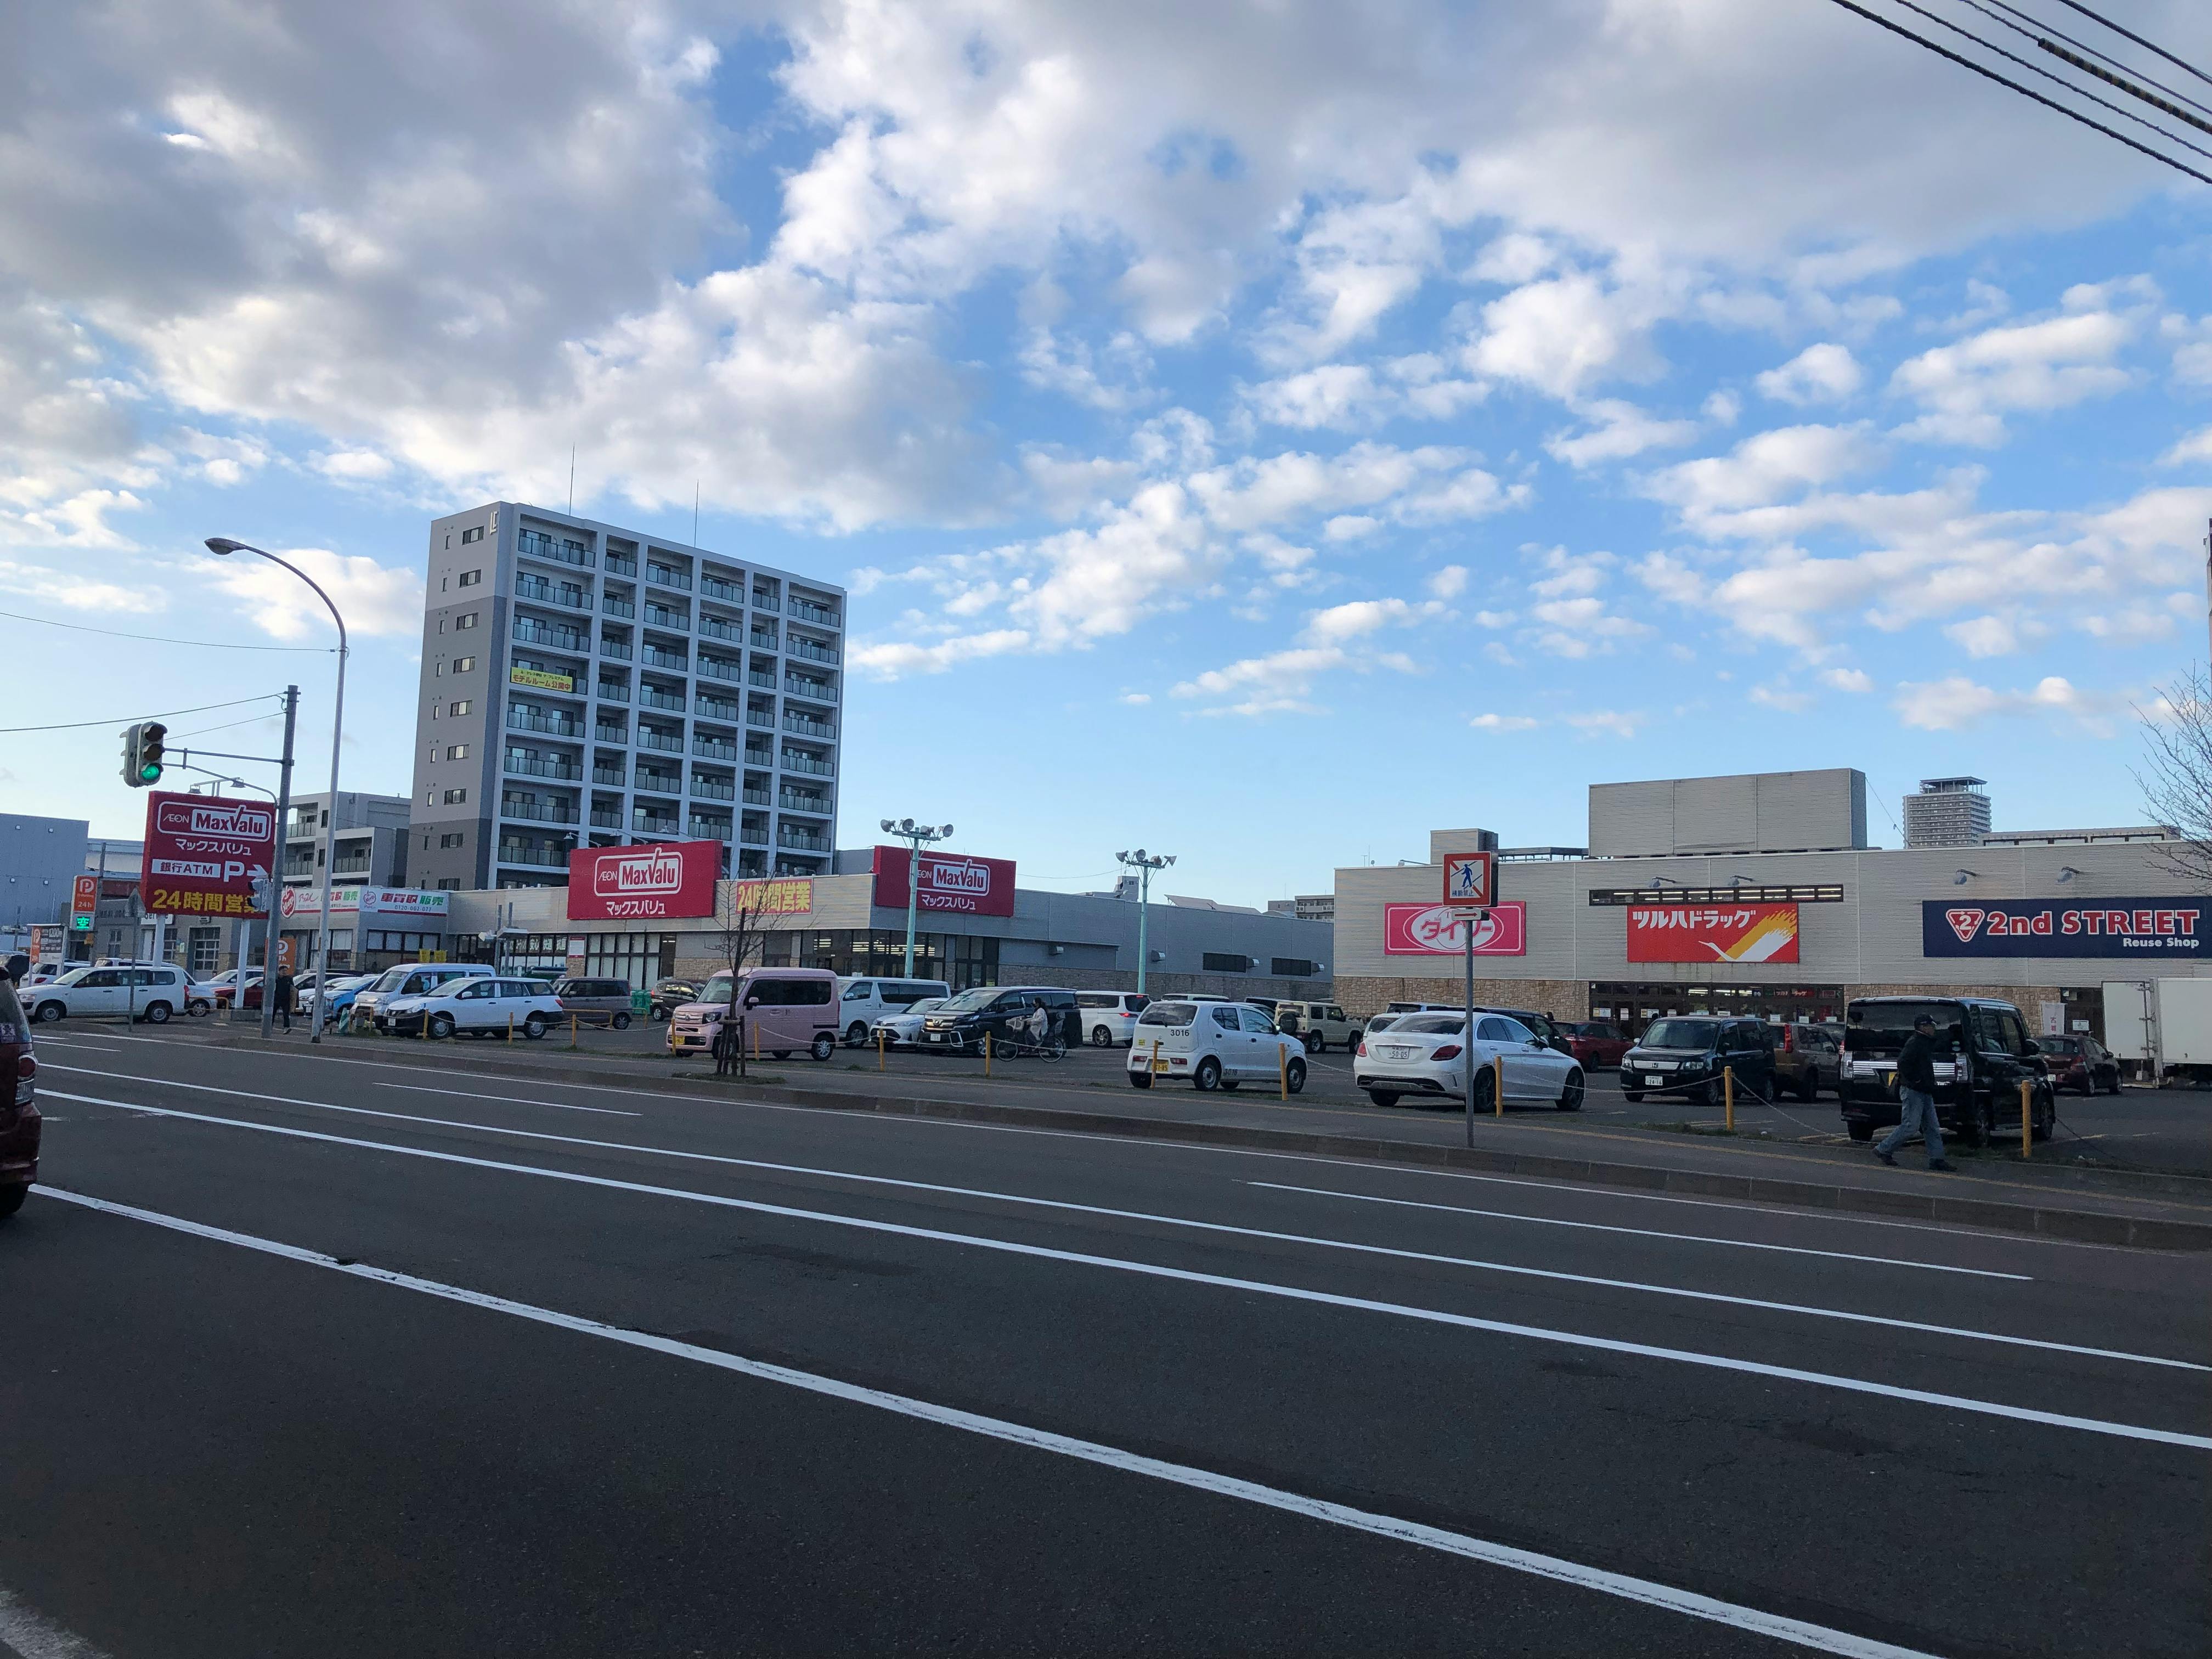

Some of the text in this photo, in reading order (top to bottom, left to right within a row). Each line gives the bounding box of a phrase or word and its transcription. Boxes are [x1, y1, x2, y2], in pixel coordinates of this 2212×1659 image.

[513, 674, 571, 690] モデルルーム公開中
[195, 806, 263, 834] MaxValu
[175, 838, 252, 856] マックスバリュ
[160, 861, 213, 875] 銀行ATM
[622, 850, 675, 885] MaxValu
[936, 861, 984, 888] MaxValu
[606, 900, 665, 916] マックスバリュ
[921, 894, 976, 910] マックスバリュ
[1632, 910, 1756, 929] ツルハドラッグ
[1987, 910, 2200, 935] 2nd STREET
[2123, 937, 2200, 949] Reuse Shop
